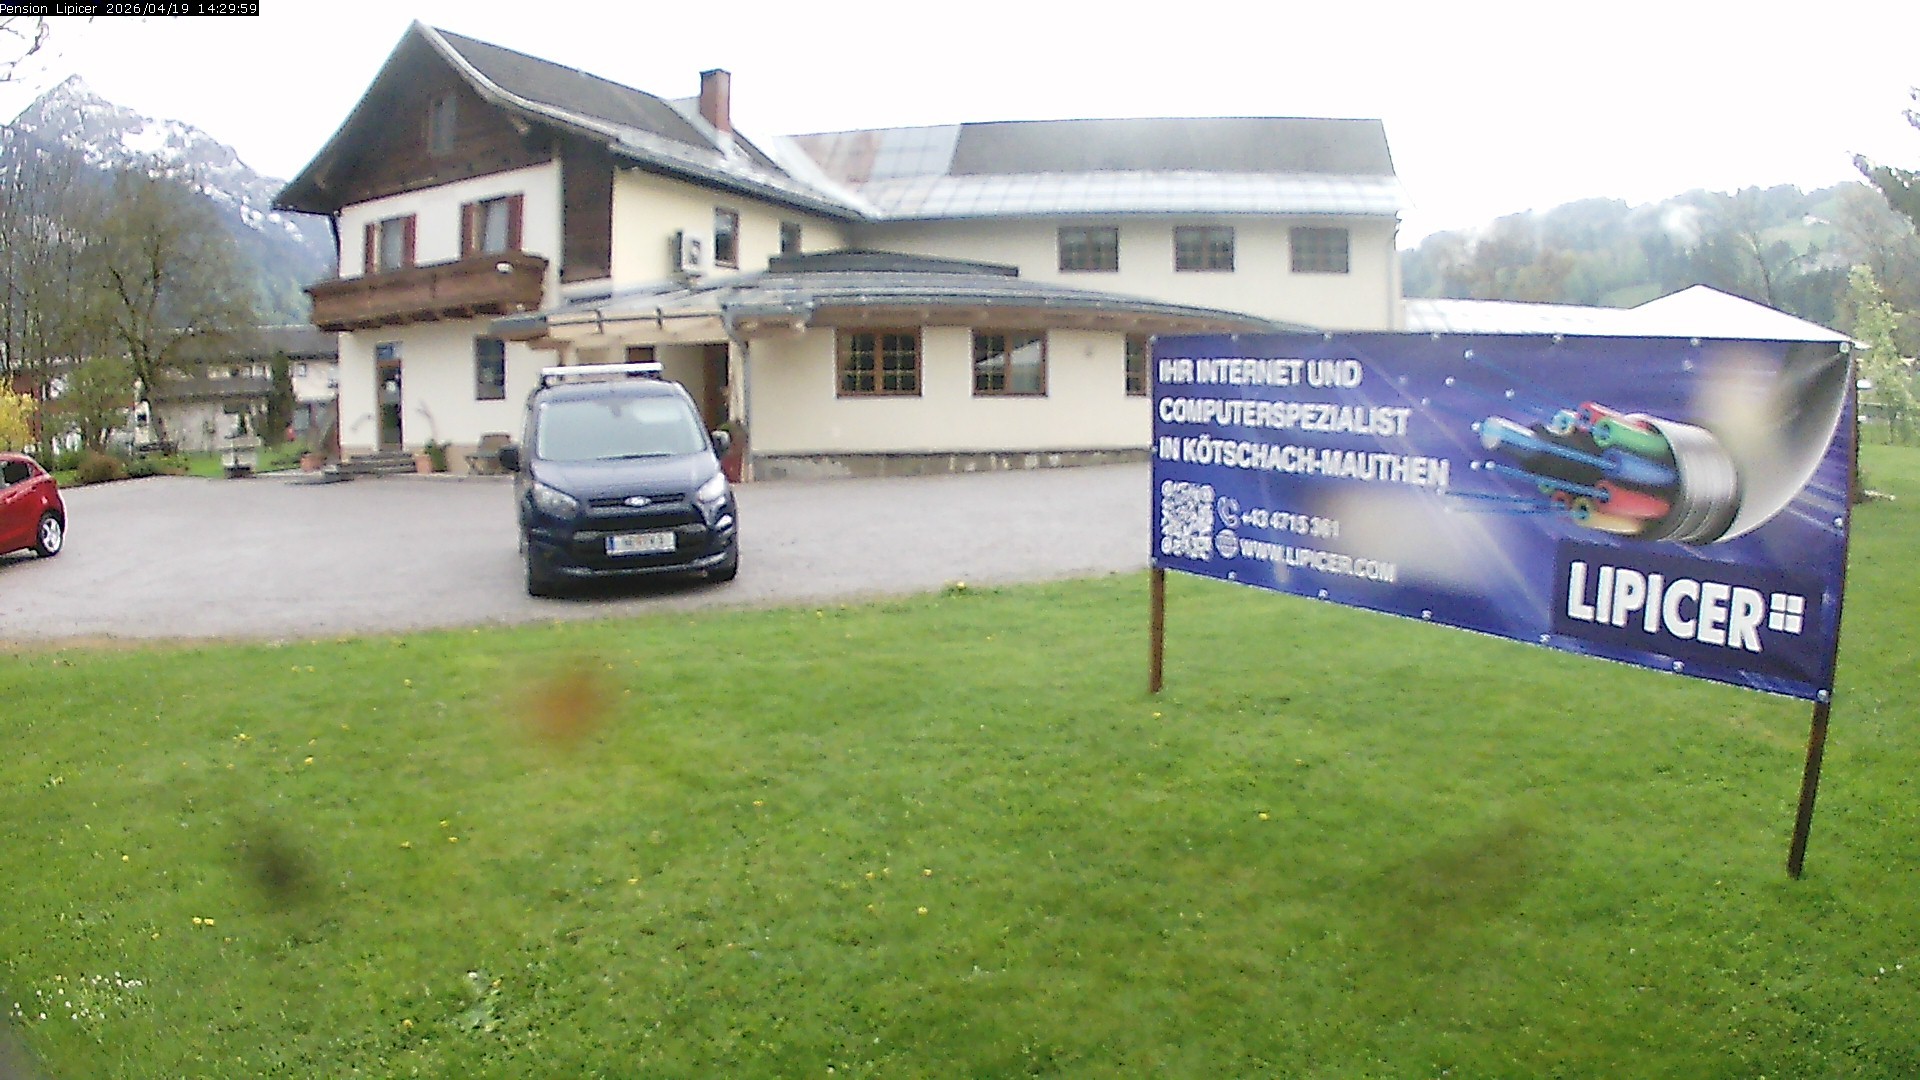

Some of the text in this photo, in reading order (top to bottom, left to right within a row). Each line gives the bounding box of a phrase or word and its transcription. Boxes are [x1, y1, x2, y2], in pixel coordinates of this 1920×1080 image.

[1159, 358, 1364, 388] IHR INTERNET UND
[1159, 396, 1412, 436] COMPUTERSPEZIALIST
[1159, 434, 1449, 486] IN KÖTSCHACH-MAUTHEN
[1241, 508, 1269, 529] +43
[1239, 538, 1397, 583] WWW.LIPICER.COM
[1567, 561, 1766, 653] LIPICER
